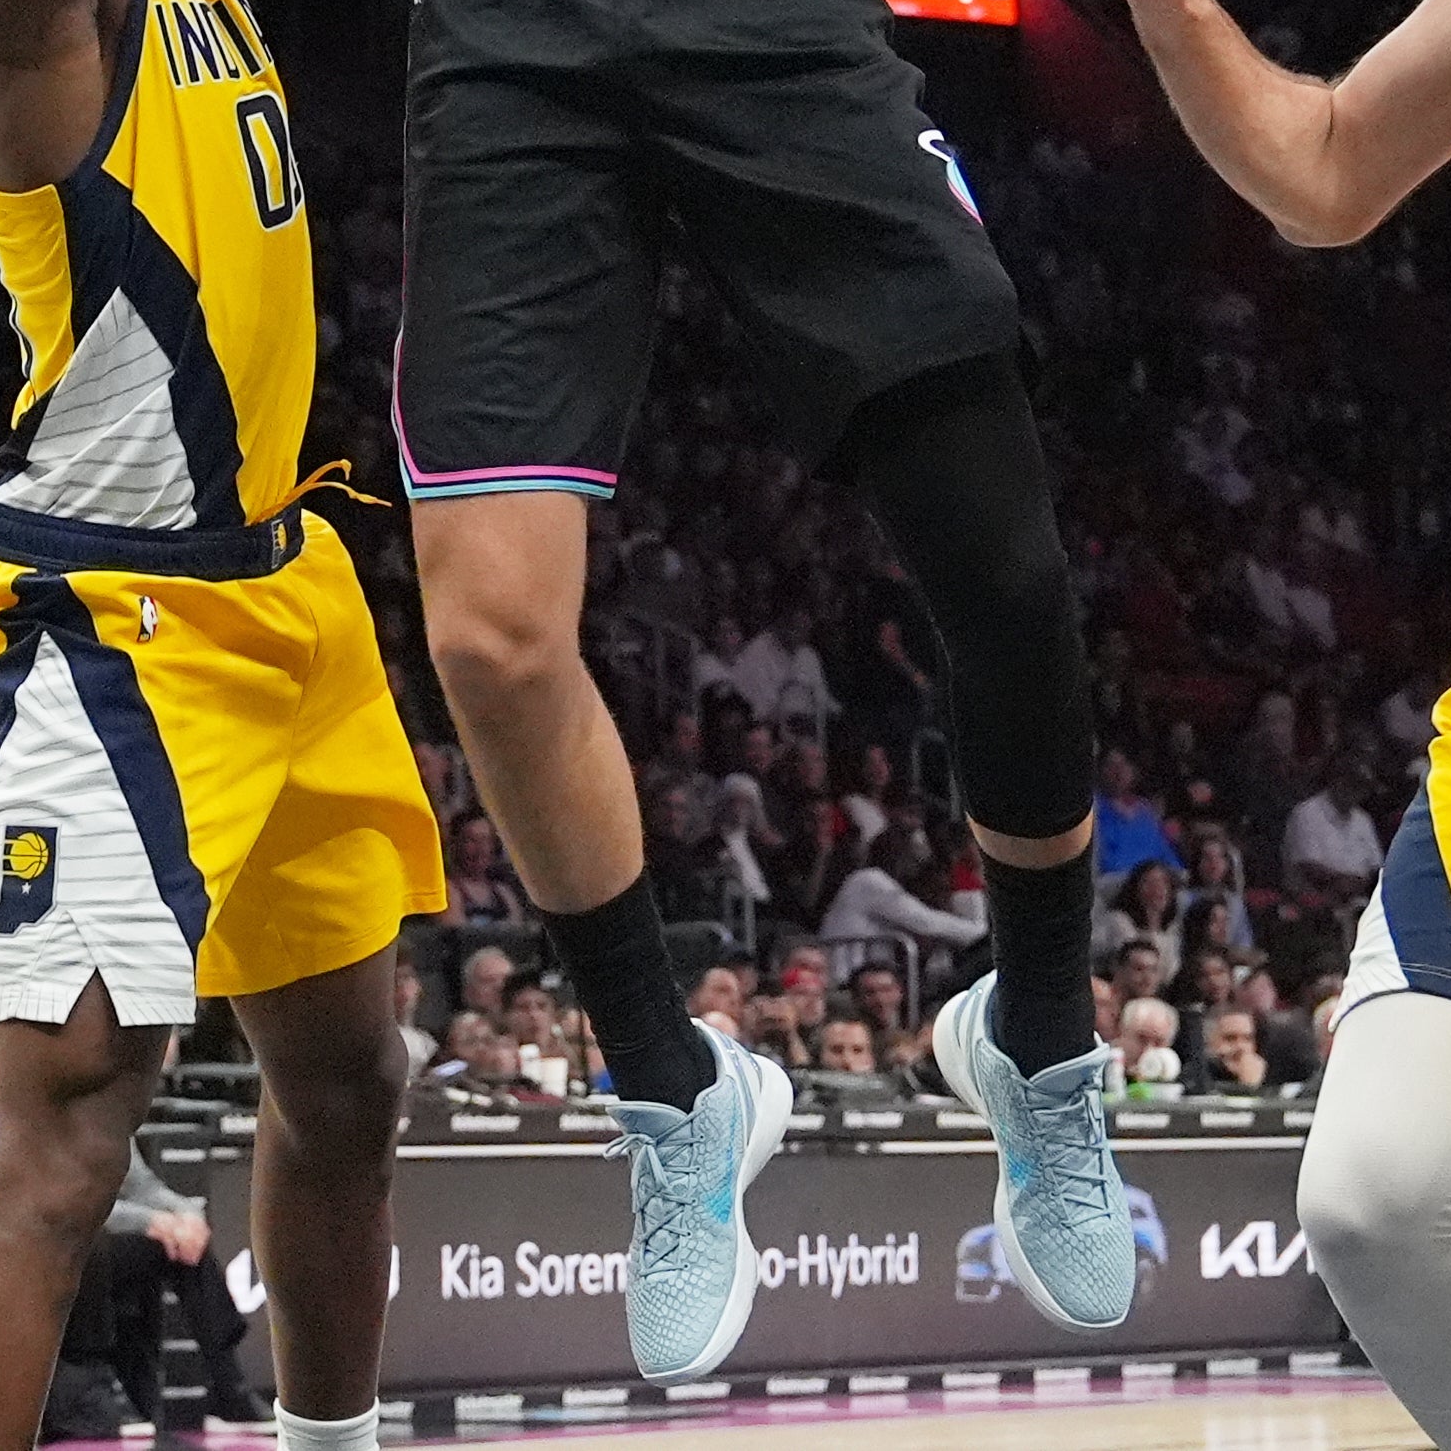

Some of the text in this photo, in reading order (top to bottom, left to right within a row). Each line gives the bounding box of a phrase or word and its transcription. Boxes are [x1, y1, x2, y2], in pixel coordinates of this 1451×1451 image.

[236, 89, 306, 233] 0
[440, 1242, 505, 1300] Kia
[515, 1240, 632, 1298] Soren
[753, 1231, 920, 1300] o-Hybrid
